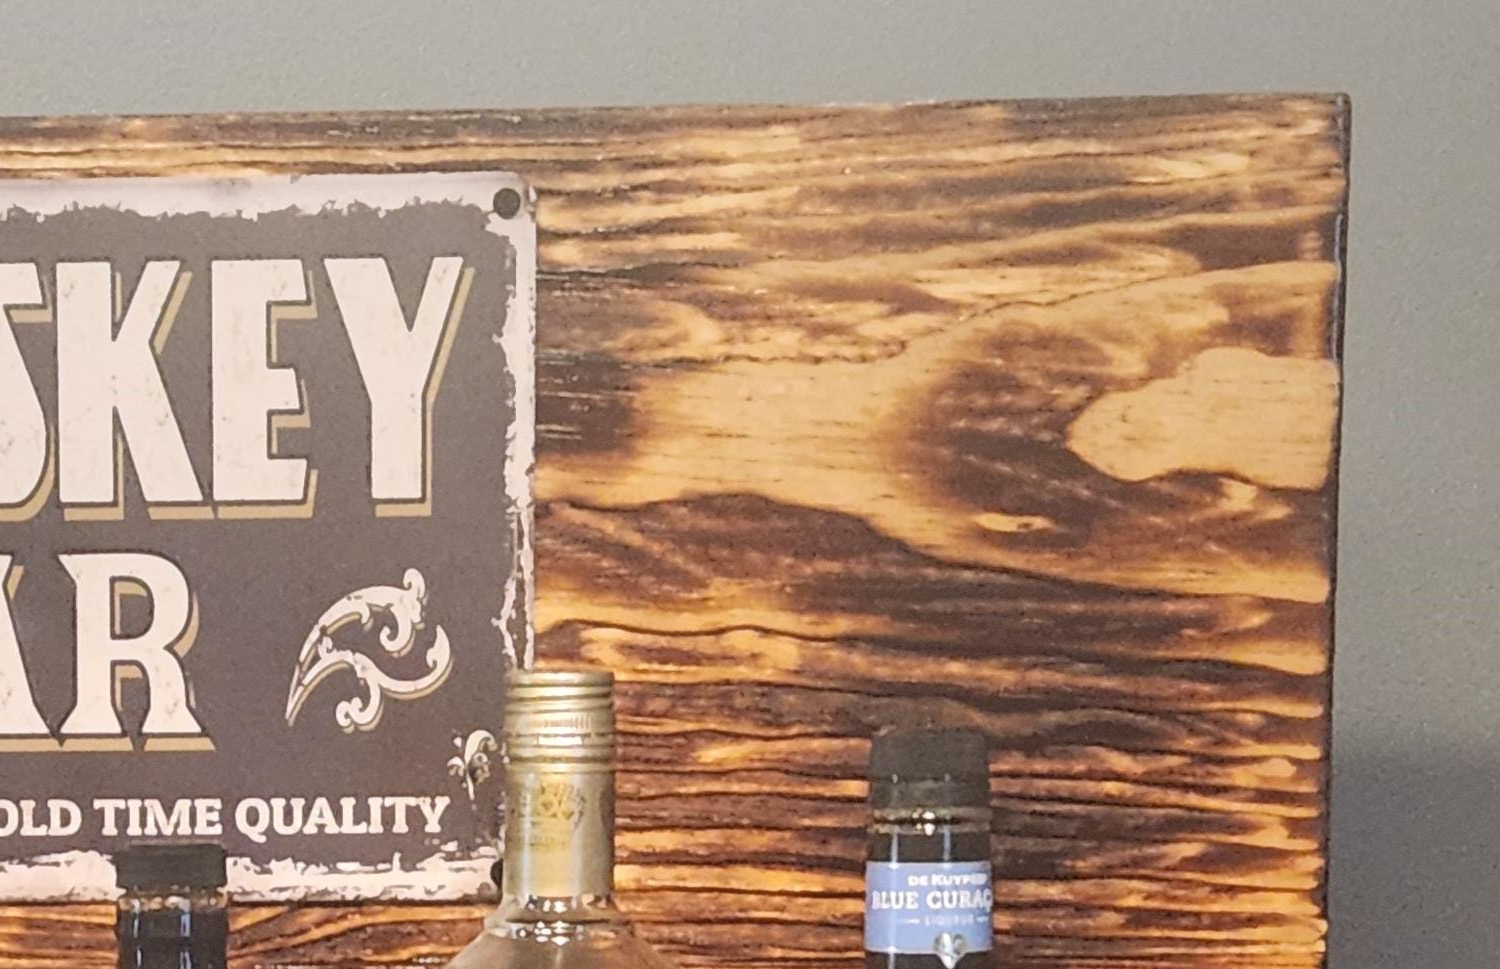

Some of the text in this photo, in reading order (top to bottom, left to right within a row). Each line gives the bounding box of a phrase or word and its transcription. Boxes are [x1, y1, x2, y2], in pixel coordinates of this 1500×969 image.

[94, 799, 222, 836] TIME
[235, 796, 450, 843] QUALITY
[871, 890, 919, 910] BLUE
